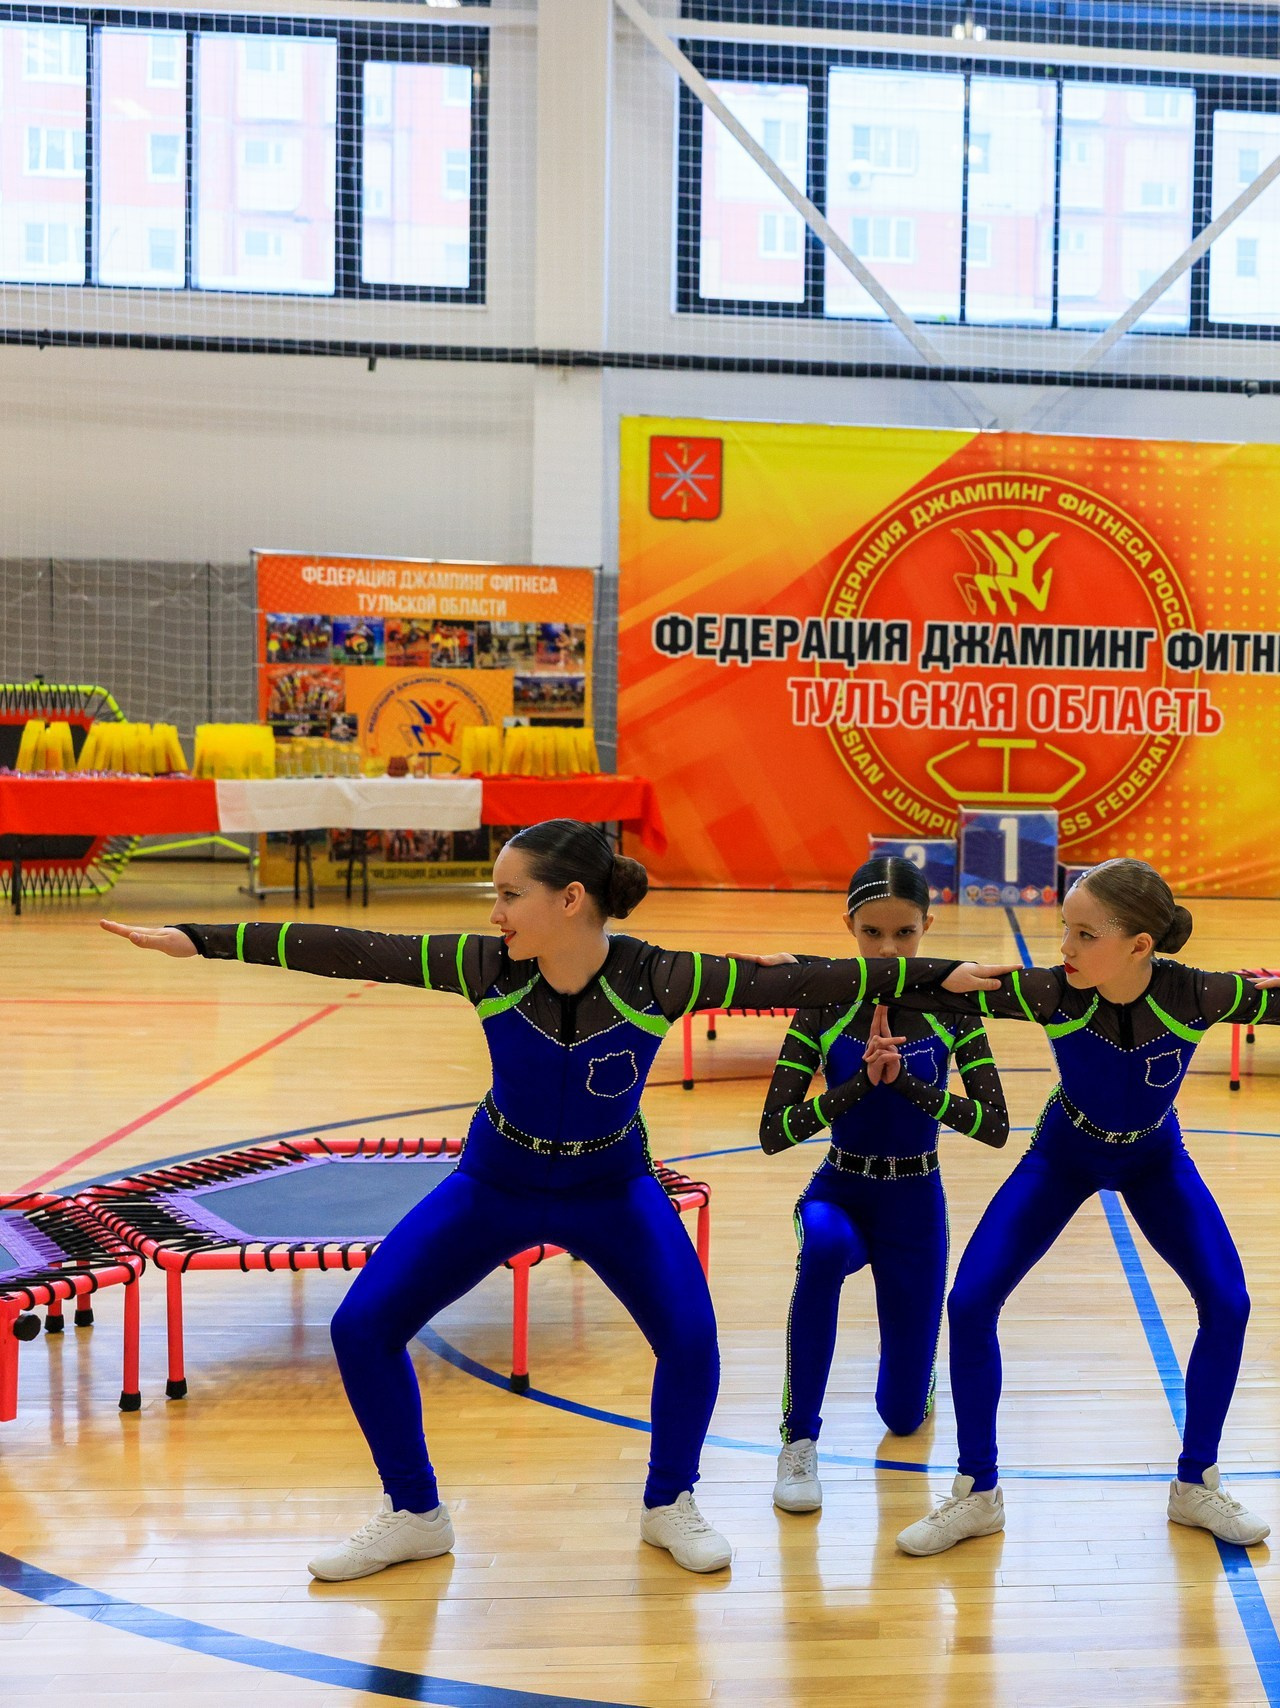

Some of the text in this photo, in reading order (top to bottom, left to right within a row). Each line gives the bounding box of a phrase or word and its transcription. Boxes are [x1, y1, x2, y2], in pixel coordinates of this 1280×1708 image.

[302, 566, 558, 594] ФЕДЕРАЦИЯ ДЖАМПИНГ ФИТНЕСА
[834, 482, 1184, 630] ДЕРАЦИЯ ДЖАМПИНГ ФИТНЕСА РОСС
[358, 593, 507, 617] ТУЛЬСКОЙ ОБЛАСТИ
[653, 613, 911, 671] ФЕДЕРАЦИЯ
[921, 622, 1155, 672] ДЖАМПИНГ
[787, 677, 1224, 737] ТУЛЬСКАЯ ОБЛАСТЬ
[1000, 818, 1017, 882] 1
